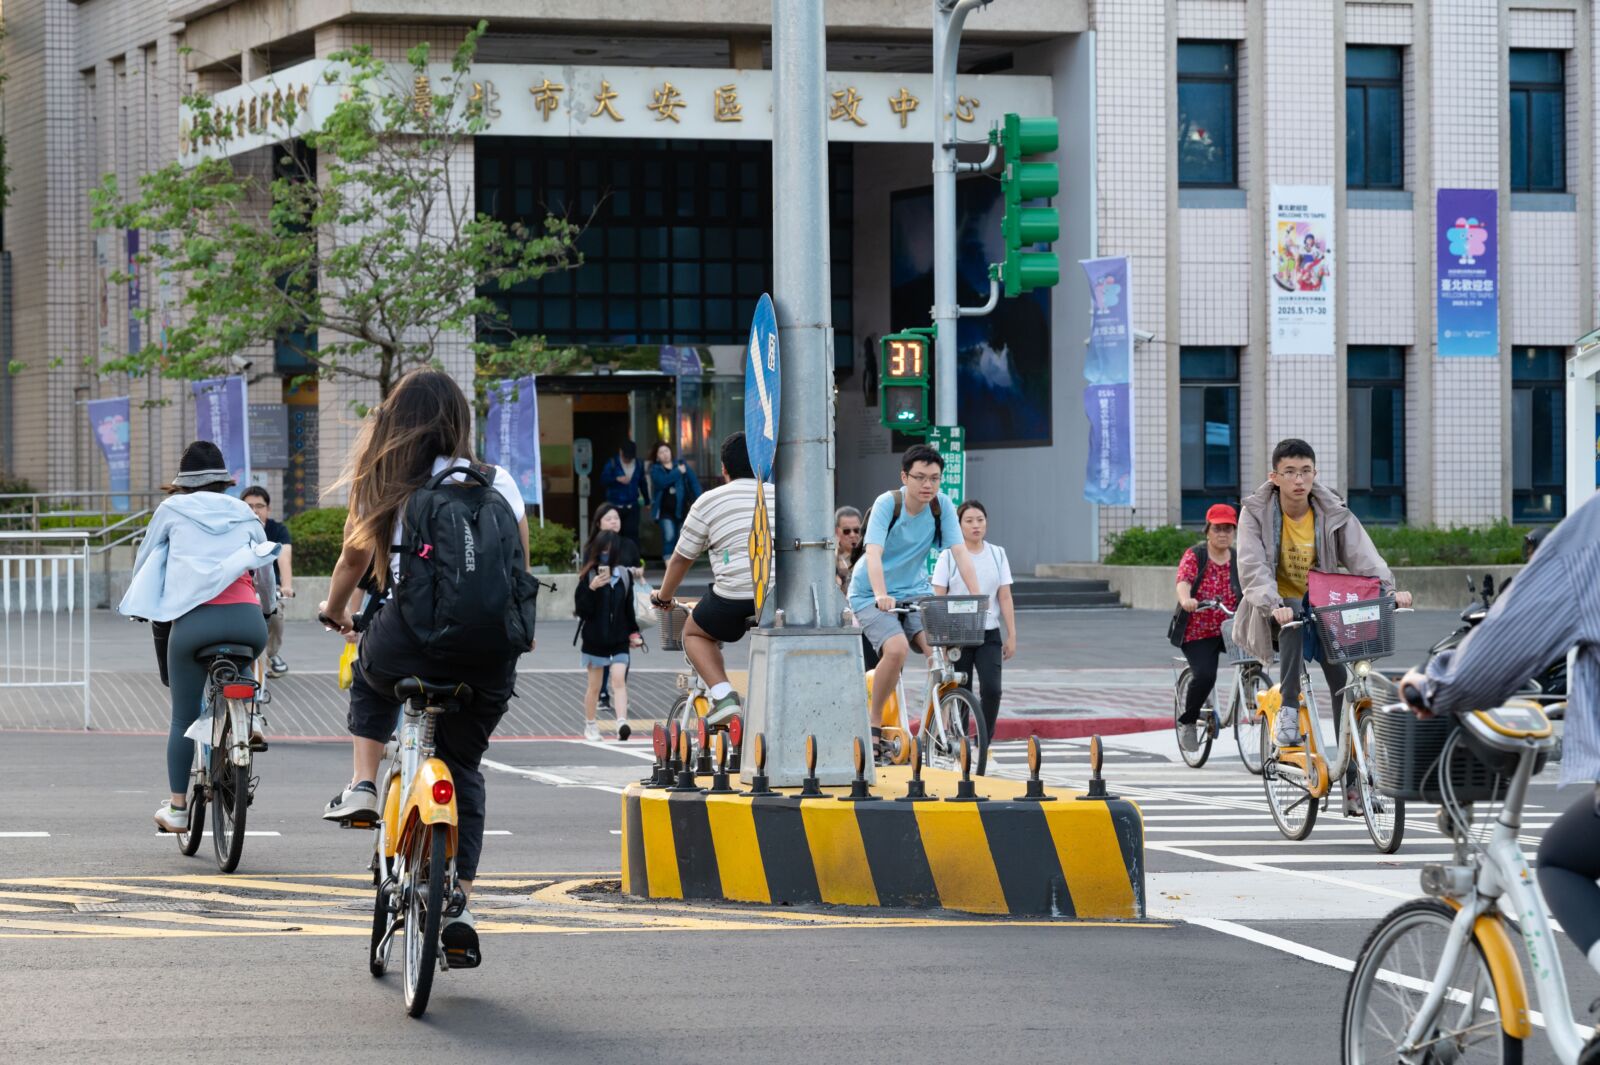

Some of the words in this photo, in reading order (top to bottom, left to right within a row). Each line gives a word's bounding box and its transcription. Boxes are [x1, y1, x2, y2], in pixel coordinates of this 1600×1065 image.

[413, 76, 979, 128] 臺北市大安區政中心
[1278, 306, 1327, 315] 2025.5.17-30
[891, 342, 921, 376] 37
